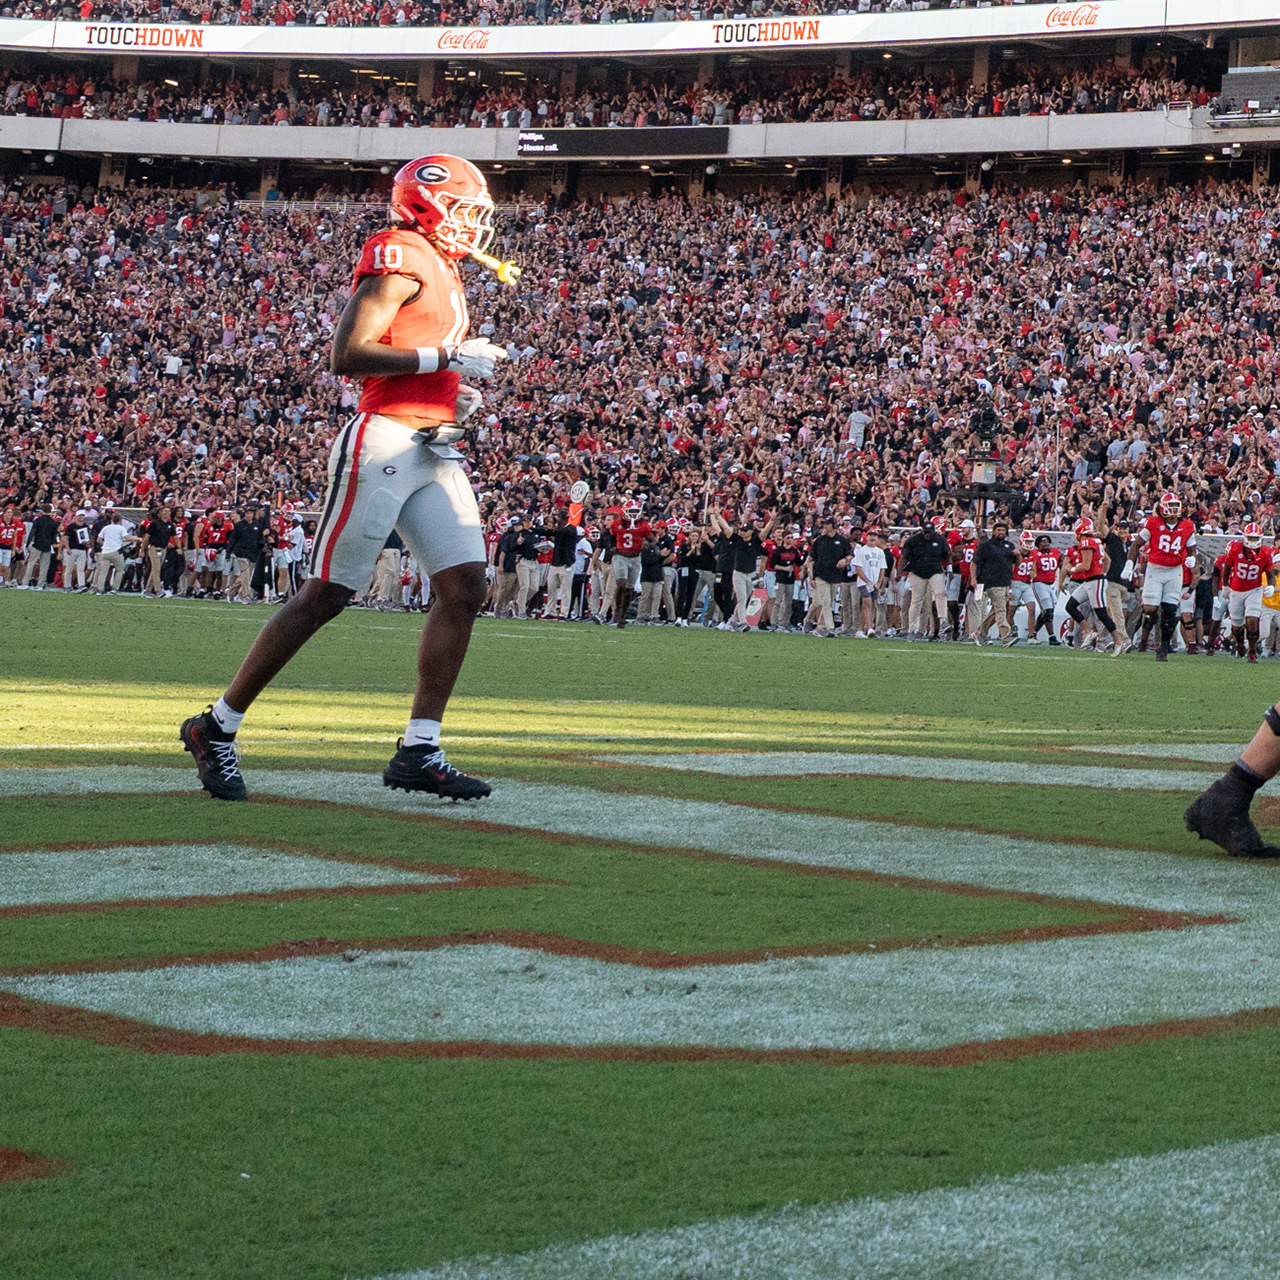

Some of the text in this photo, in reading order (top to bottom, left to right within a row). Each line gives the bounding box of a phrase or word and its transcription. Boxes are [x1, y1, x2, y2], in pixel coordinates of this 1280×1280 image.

[1046, 4, 1102, 27] Coca-Cola
[85, 26, 204, 47] TOUCHDOWN
[437, 30, 491, 49] Coca-Cola
[713, 20, 820, 44] TOUCHDOWN
[523, 144, 544, 152] House
[545, 144, 558, 152] call.
[373, 244, 403, 269] 10
[213, 532, 221, 542] 7
[623, 533, 632, 548] 3
[1159, 535, 1181, 554] 64
[1041, 557, 1057, 571] 50
[1236, 563, 1260, 580] 52
